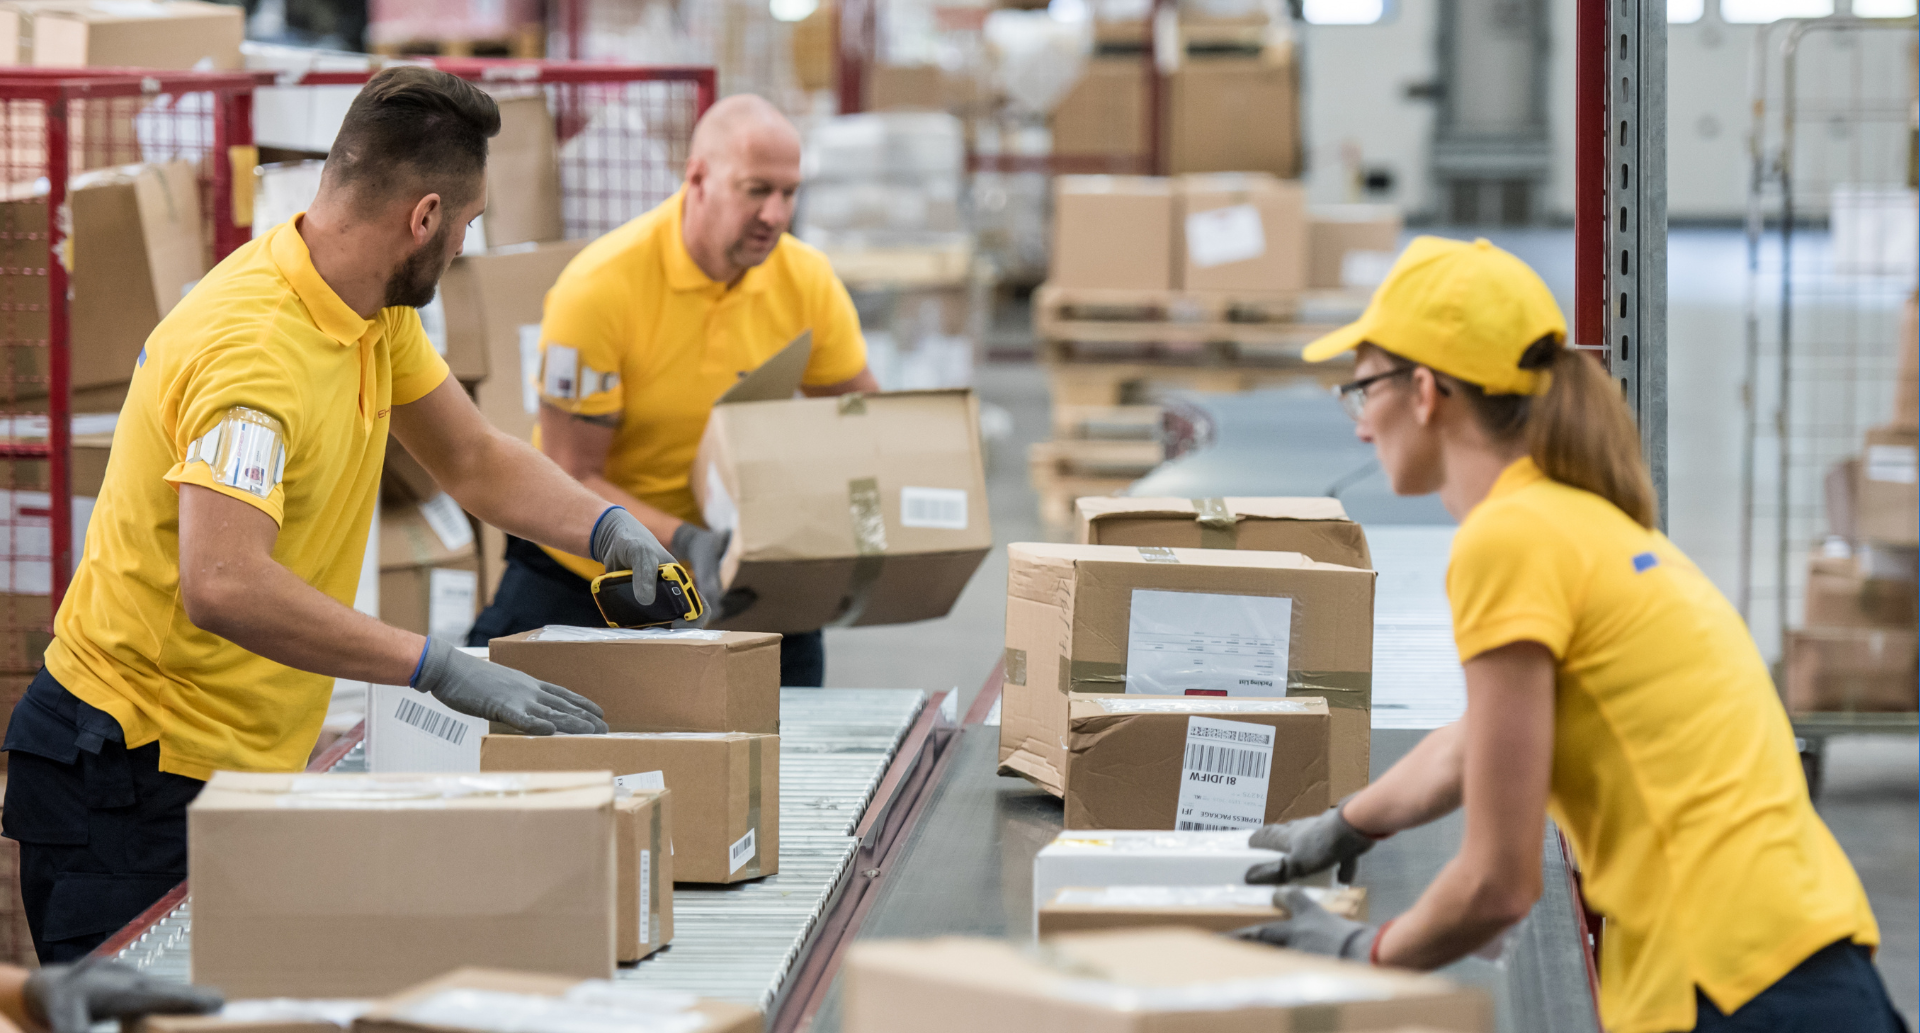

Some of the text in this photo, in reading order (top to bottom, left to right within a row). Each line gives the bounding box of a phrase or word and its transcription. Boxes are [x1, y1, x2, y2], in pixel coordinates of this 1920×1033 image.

[1250, 679, 1273, 687] Packing
[1189, 772, 1225, 784] JDIFW
[1200, 811, 1262, 825] EXPRESS PACKAGE
